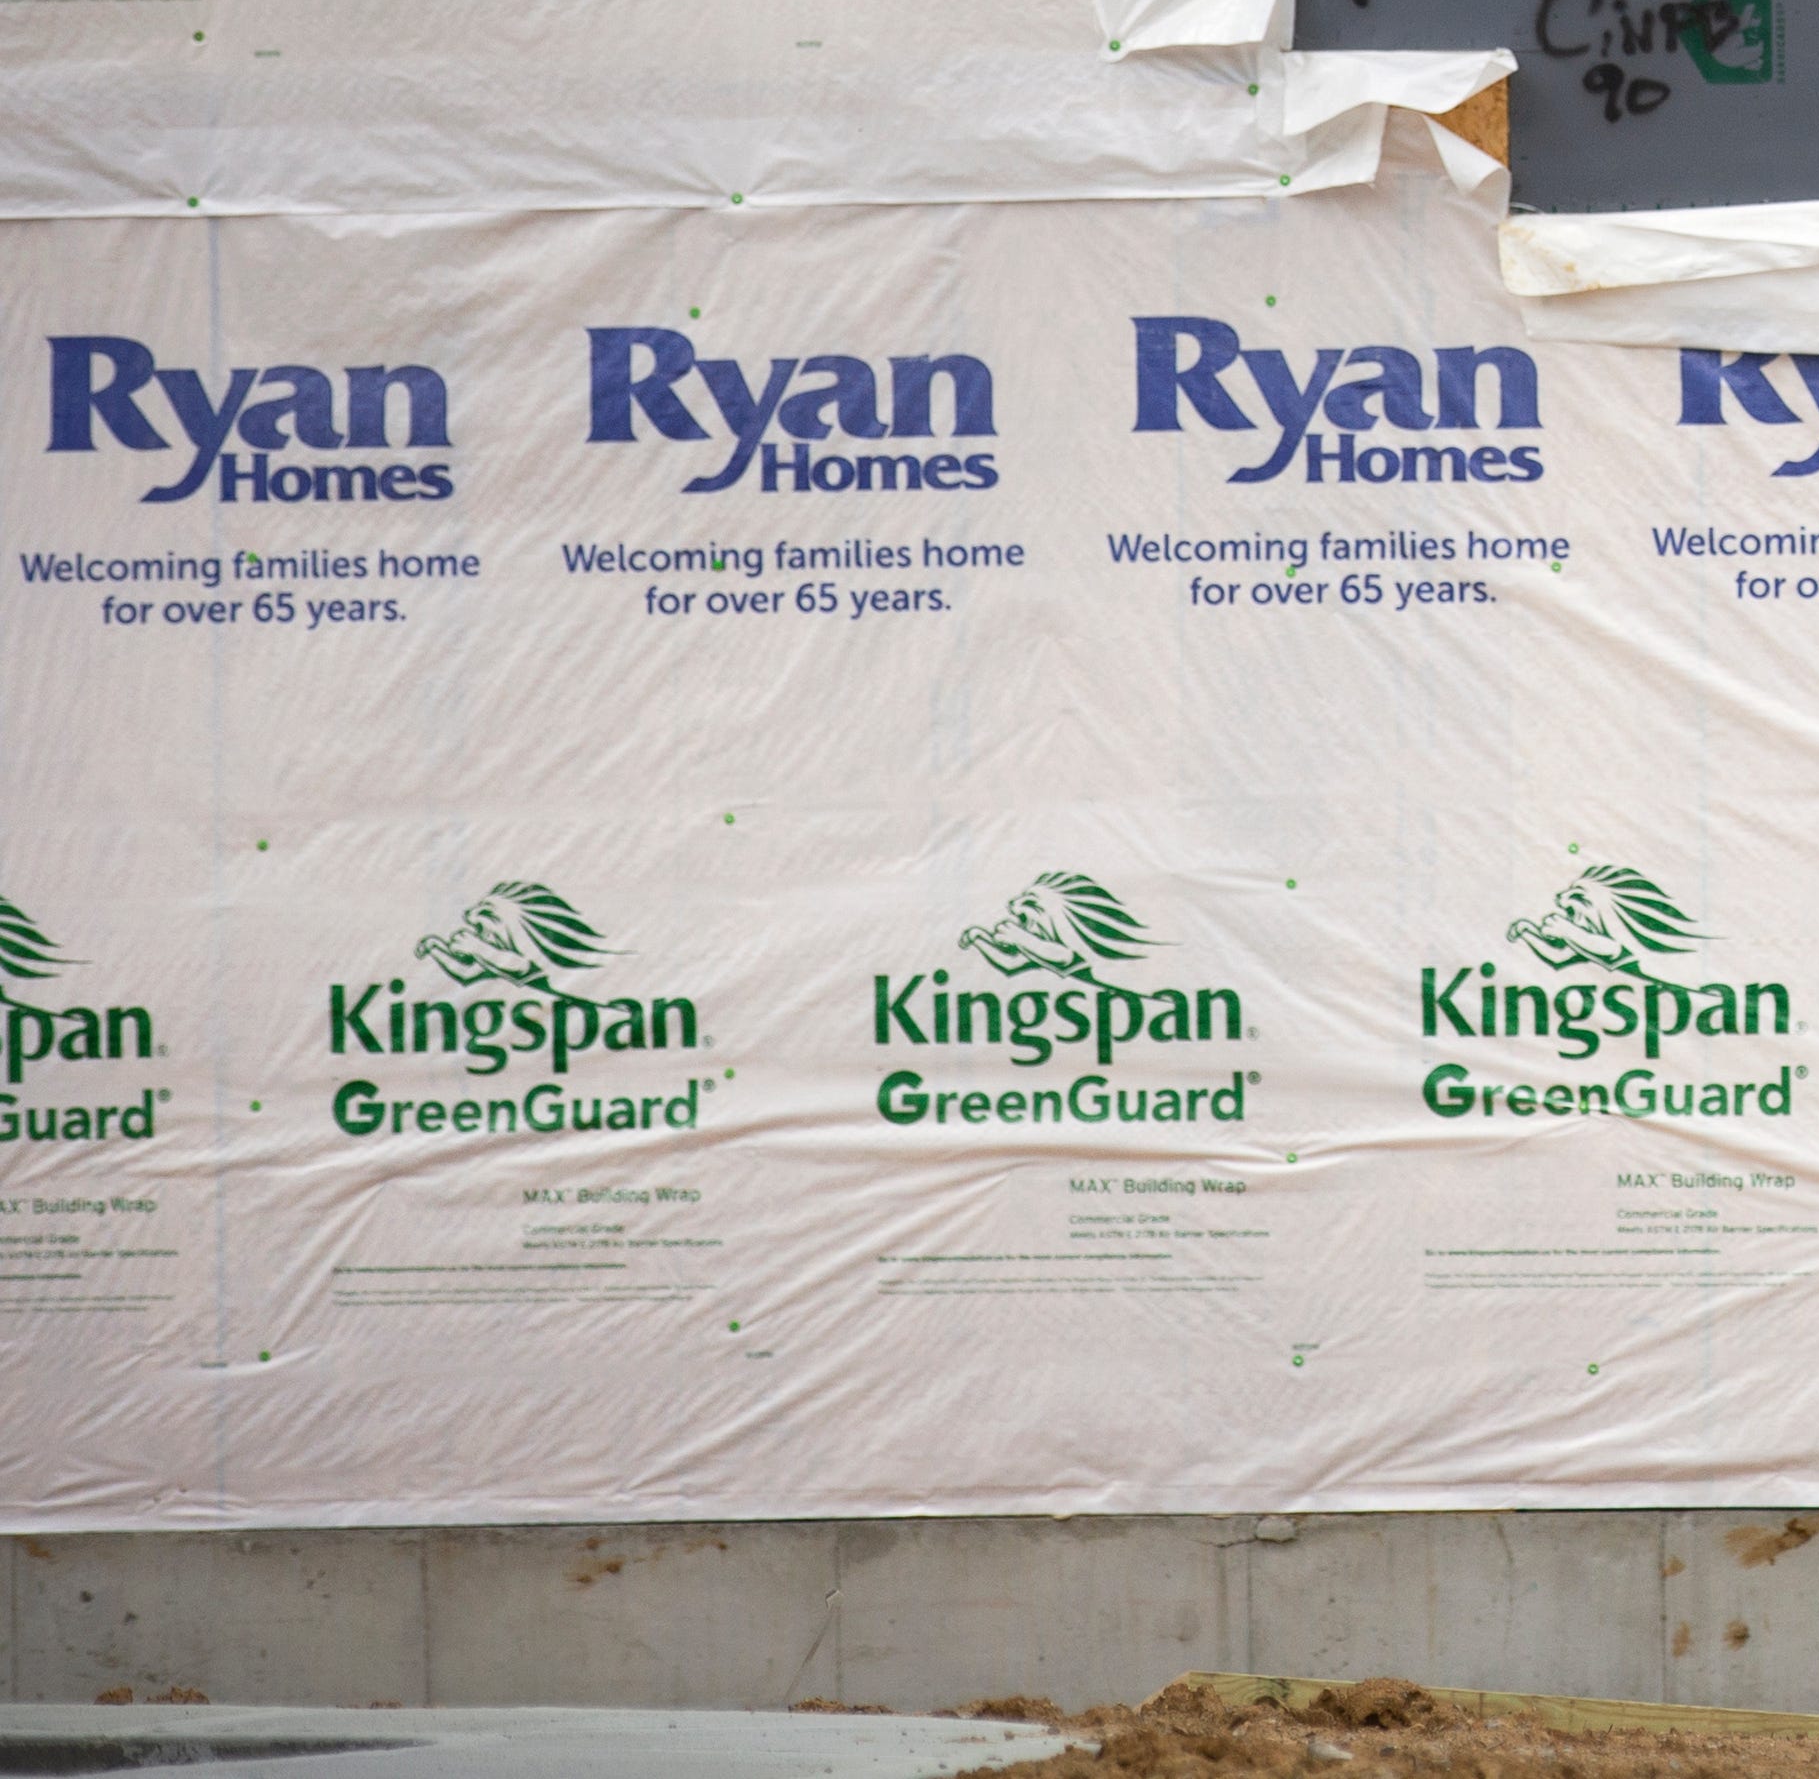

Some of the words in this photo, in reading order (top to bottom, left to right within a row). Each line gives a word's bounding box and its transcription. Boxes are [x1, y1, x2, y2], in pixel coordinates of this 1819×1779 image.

[46, 336, 454, 503] Ryan
[586, 327, 999, 493] Ryan
[1131, 316, 1544, 483] Ryan
[215, 448, 454, 502] Homes
[755, 439, 999, 492] Homes
[1300, 428, 1544, 483] Homes
[20, 552, 221, 588] Welcoming
[233, 549, 368, 579] families
[379, 550, 480, 577] home
[562, 542, 763, 578] Welcoming
[775, 540, 911, 570] families
[923, 538, 1024, 567] home
[1108, 532, 1307, 573] Welcoming
[1320, 531, 1456, 560] families
[1468, 531, 1570, 559] home
[102, 595, 154, 624] for
[163, 601, 243, 624] over
[253, 592, 295, 623] 65
[307, 599, 406, 630] years.
[645, 585, 696, 614] for
[706, 592, 785, 614] over
[796, 583, 838, 612] 65
[851, 589, 950, 620] years.
[1191, 577, 1240, 605] for
[1251, 583, 1329, 604] over
[1340, 574, 1383, 604] 65
[1395, 581, 1496, 611] years.
[1736, 570, 1786, 599] for
[328, 977, 698, 1074] Kingspan
[873, 968, 1243, 1067] Kingspan
[1421, 961, 1791, 1061] Kingspan
[332, 1080, 699, 1136] GreenGuard
[876, 1069, 1245, 1125] GreenGuard
[1422, 1063, 1792, 1119] GreenGuard
[655, 1188, 700, 1203] Wrap
[1123, 1178, 1196, 1196] Building
[1201, 1180, 1247, 1195] Wrap
[1617, 1174, 1657, 1187] MAX
[1671, 1172, 1744, 1191] Building
[1750, 1173, 1795, 1188] Wrap
